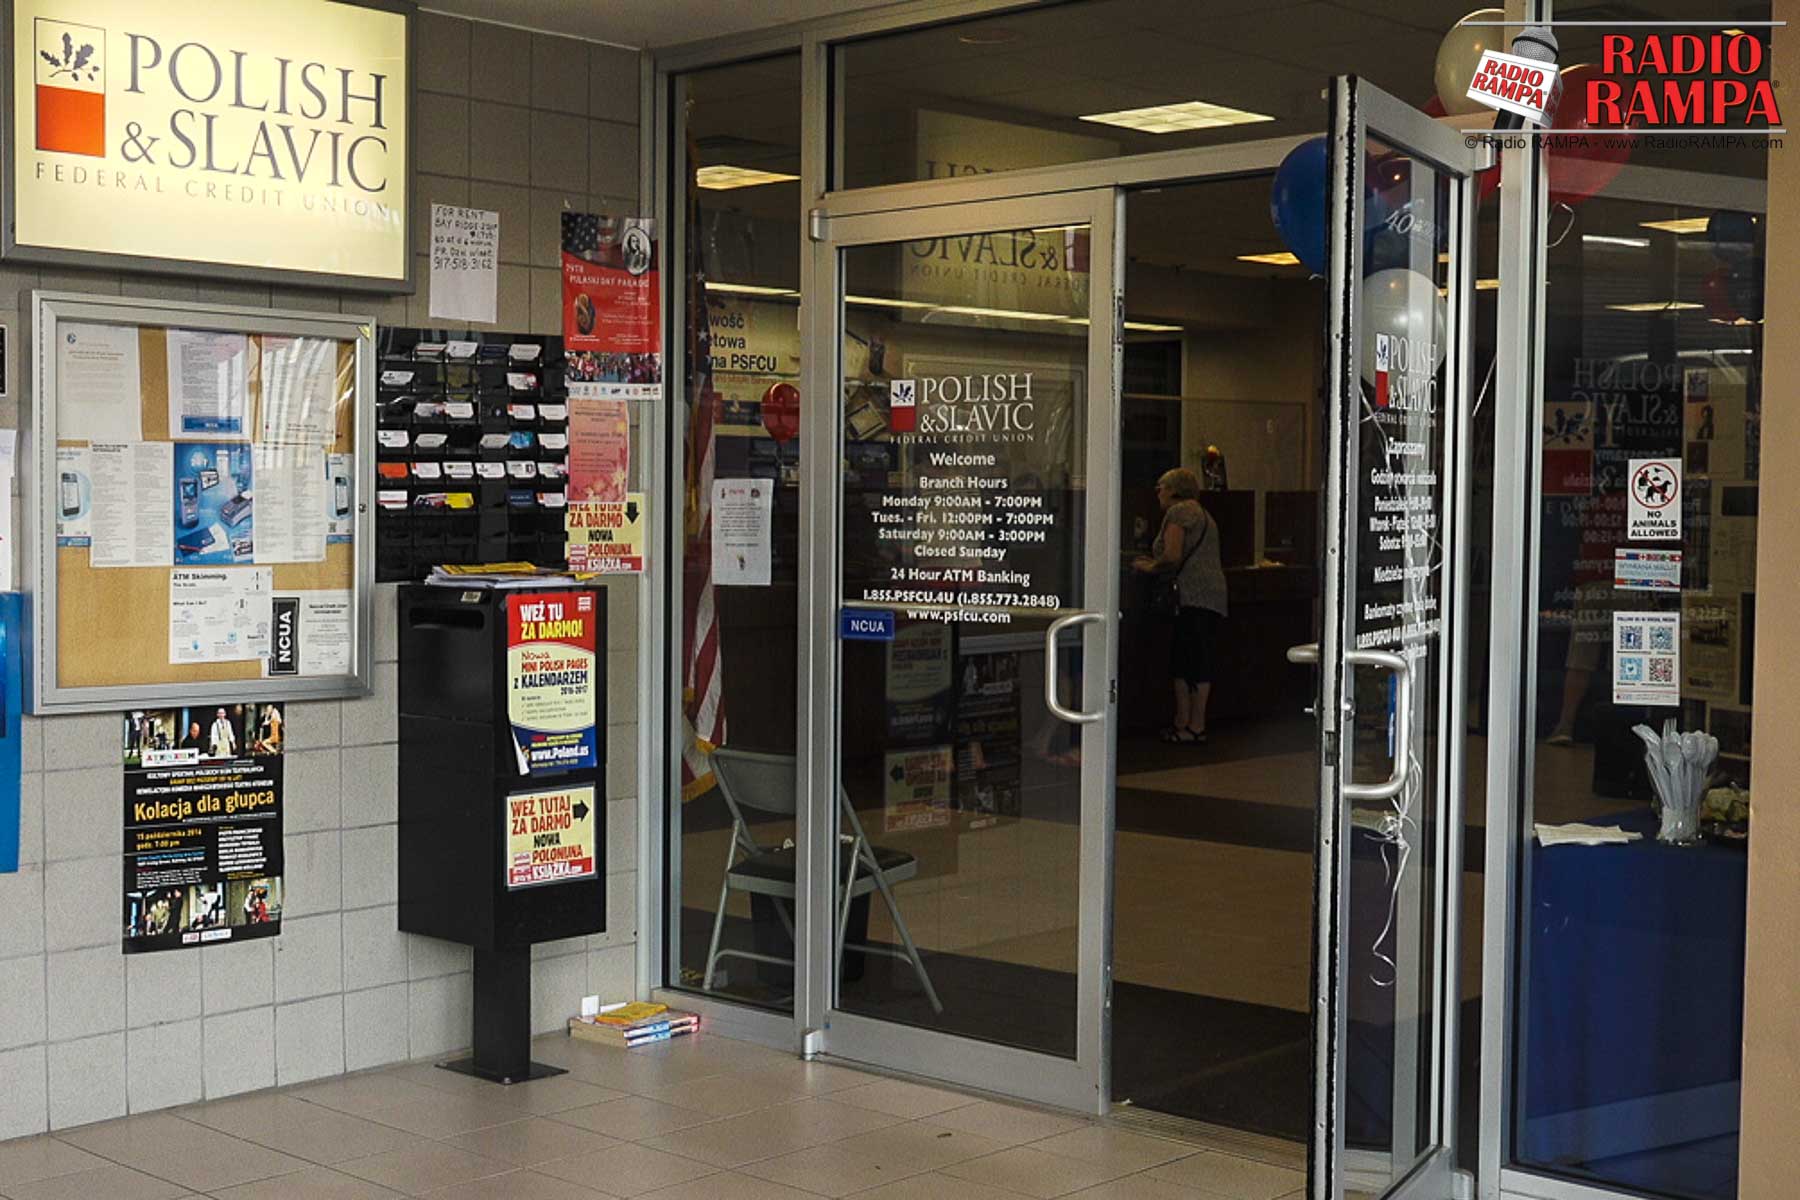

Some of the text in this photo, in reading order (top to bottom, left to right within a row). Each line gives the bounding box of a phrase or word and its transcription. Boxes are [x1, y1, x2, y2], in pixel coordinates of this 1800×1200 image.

[124, 32, 388, 130] POLISH
[36, 161, 389, 218] FEDERAL CREDIT UNION
[731, 353, 777, 371] PSFCU
[922, 372, 1034, 404] POLISH
[890, 434, 1035, 445] FEDERAL CREDIT UNION
[930, 453, 996, 466] Welcome
[919, 476, 1008, 489] Branch Hours
[882, 496, 932, 508] Monday
[933, 495, 982, 508] 9:00AM
[994, 496, 1042, 508] 7:00PM
[569, 513, 623, 528] ZA DARMO
[871, 512, 905, 523] Tues.
[916, 513, 937, 523] Fri.
[942, 512, 993, 525] 12:00PM
[1006, 513, 1053, 525] 7:00PM
[1646, 511, 1662, 519] NO
[1632, 519, 1677, 528] ANIMALS
[588, 529, 614, 542] NOWA
[878, 528, 935, 542] Saturday
[938, 528, 985, 541] 9:00AM
[998, 530, 1046, 542] 3:00PM
[1630, 529, 1678, 538] ALLOWED
[914, 545, 1006, 560] Closed Sunday
[890, 568, 1031, 586] 24 Hour ATM Banking
[520, 601, 546, 622] WEŹ
[547, 603, 564, 621] TU
[907, 609, 1011, 624] www.psfcu.com
[521, 619, 584, 641] ZA DARMO!
[850, 620, 885, 633] NCUA
[278, 610, 292, 663] NCUA
[521, 661, 538, 673] MINI
[521, 670, 588, 690] KALENDARZEM
[134, 798, 193, 821] Kolacja
[197, 794, 221, 813] dla
[225, 790, 275, 814] głupca
[539, 794, 571, 815] TUTAJ
[512, 813, 571, 836] ZA DARMO
[533, 832, 561, 848] NOWA
